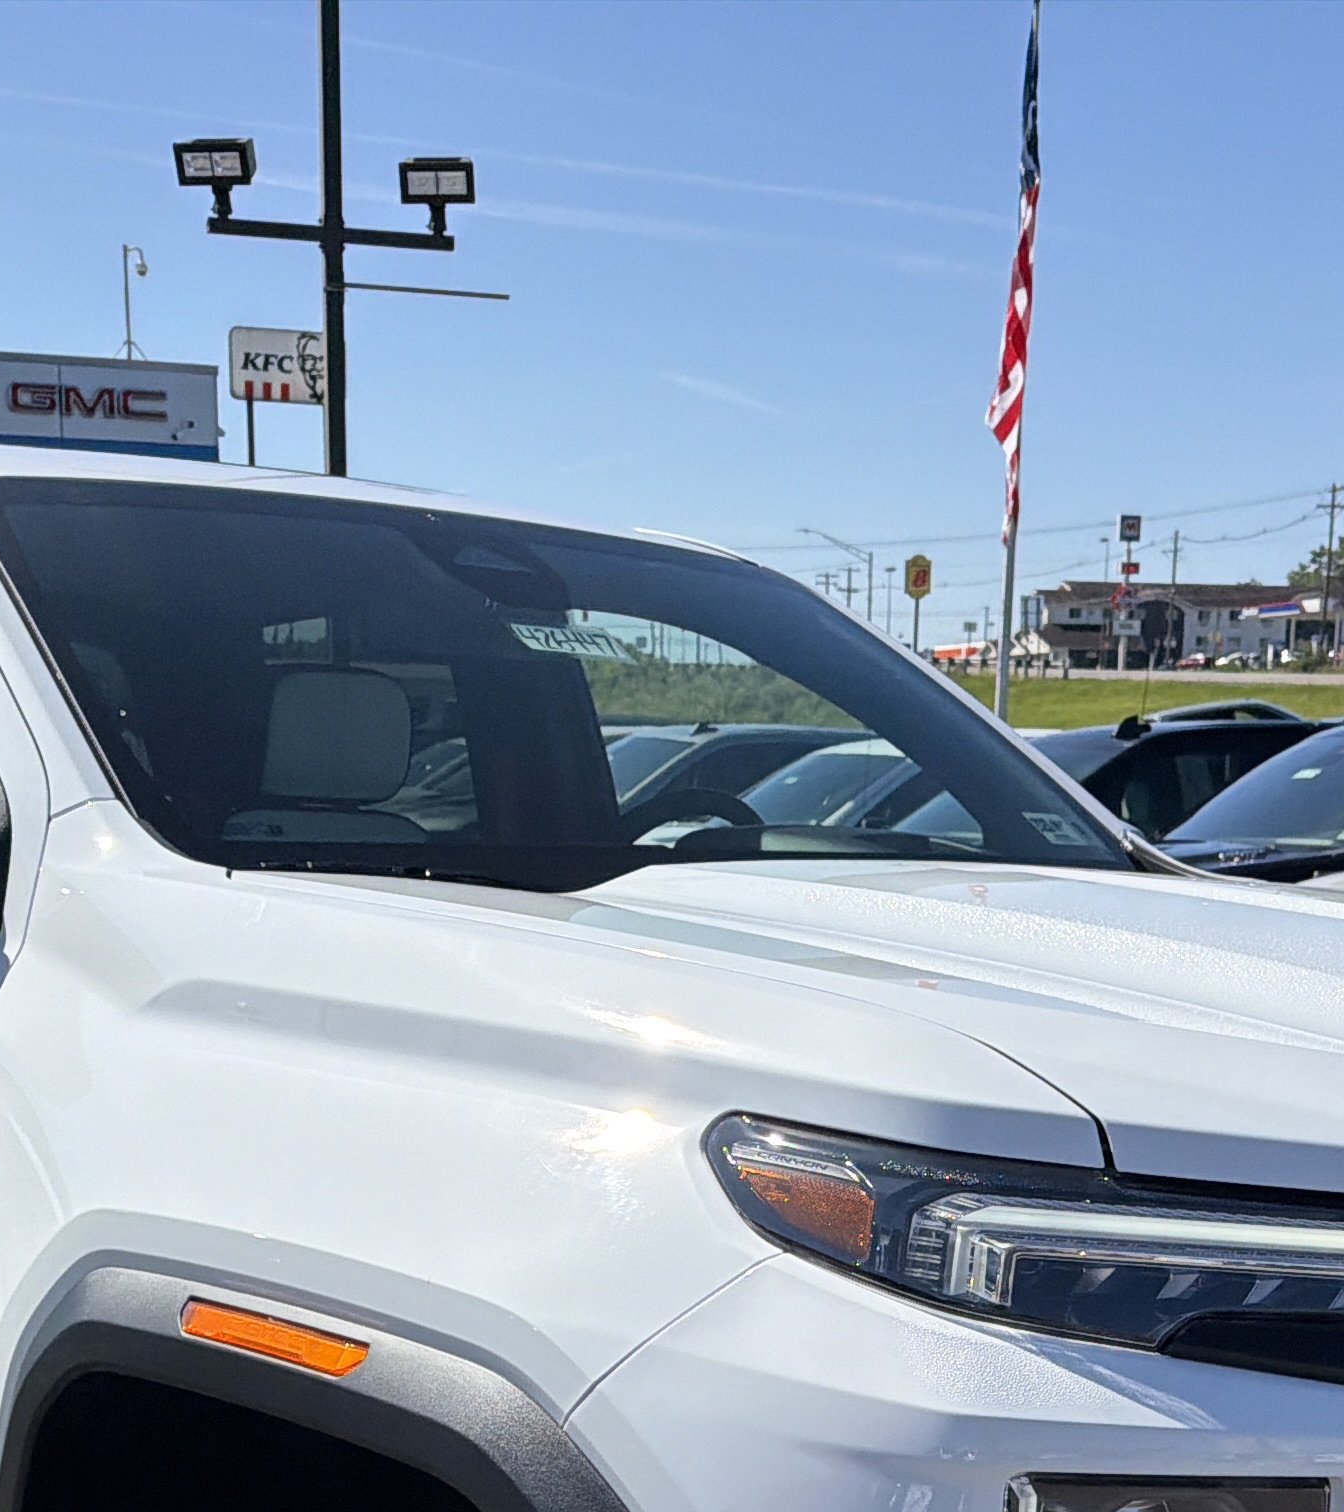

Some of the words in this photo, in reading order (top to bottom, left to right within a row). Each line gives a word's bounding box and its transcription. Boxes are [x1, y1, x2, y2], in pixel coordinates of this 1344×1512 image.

[240, 351, 295, 375] KFC
[9, 381, 169, 423] GMC
[756, 1150, 829, 1171] CANYON
